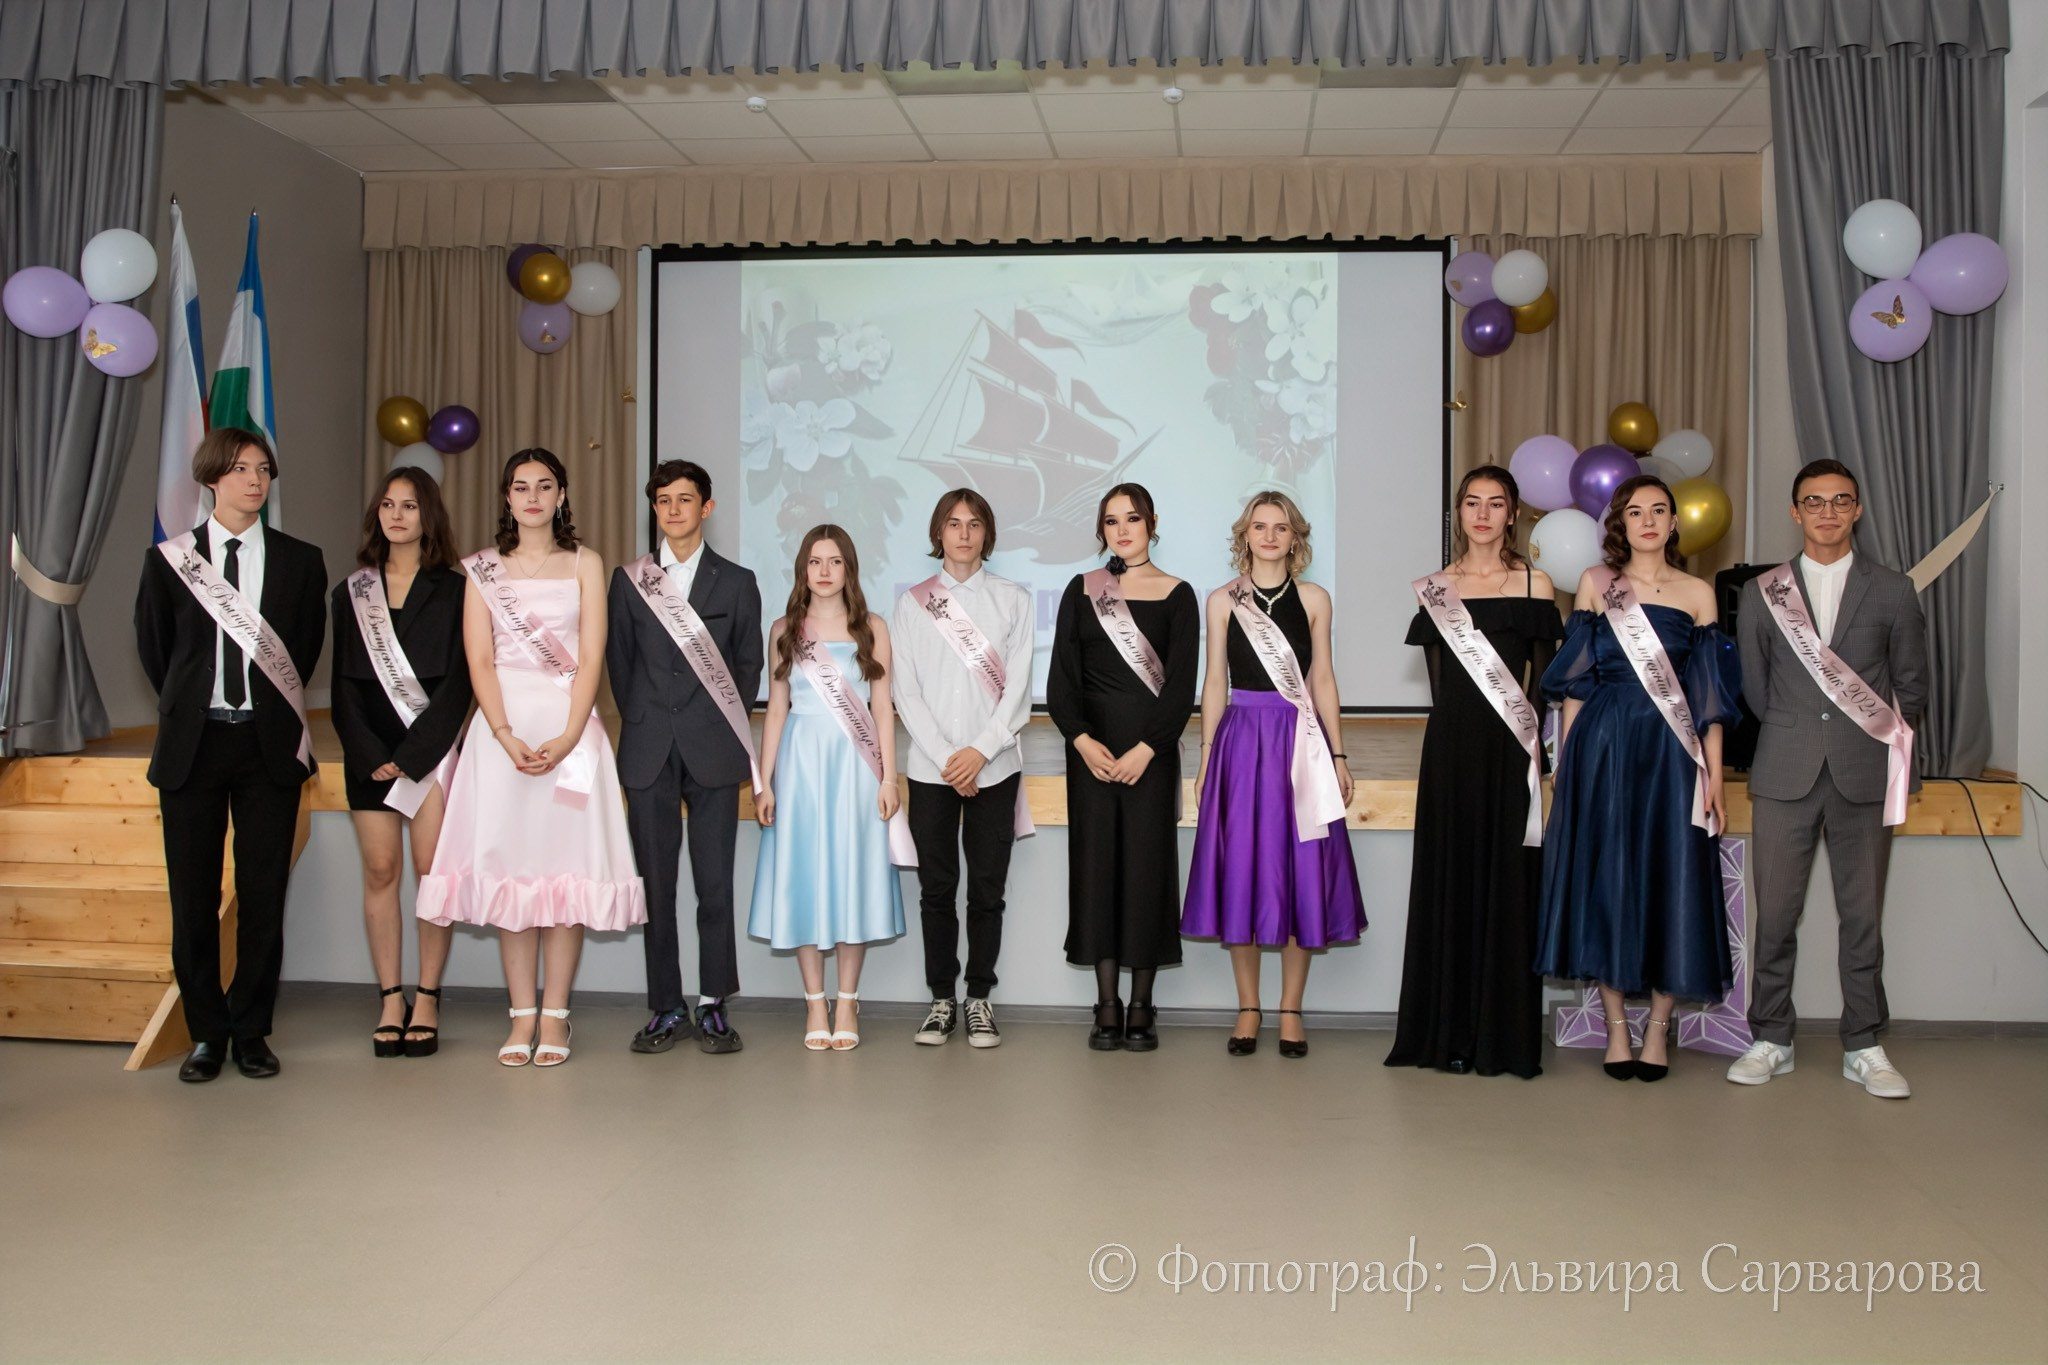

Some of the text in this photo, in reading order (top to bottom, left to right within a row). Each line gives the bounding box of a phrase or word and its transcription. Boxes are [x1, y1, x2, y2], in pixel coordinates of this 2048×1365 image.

[207, 583, 276, 659] Выпускник
[365, 605, 410, 697] Выпускница
[662, 595, 714, 672] Выпускник
[710, 669, 738, 705] 2024
[1784, 608, 1884, 718] Выпускник 2024
[817, 663, 874, 747] Выпускница
[1504, 695, 1538, 731] 2024
